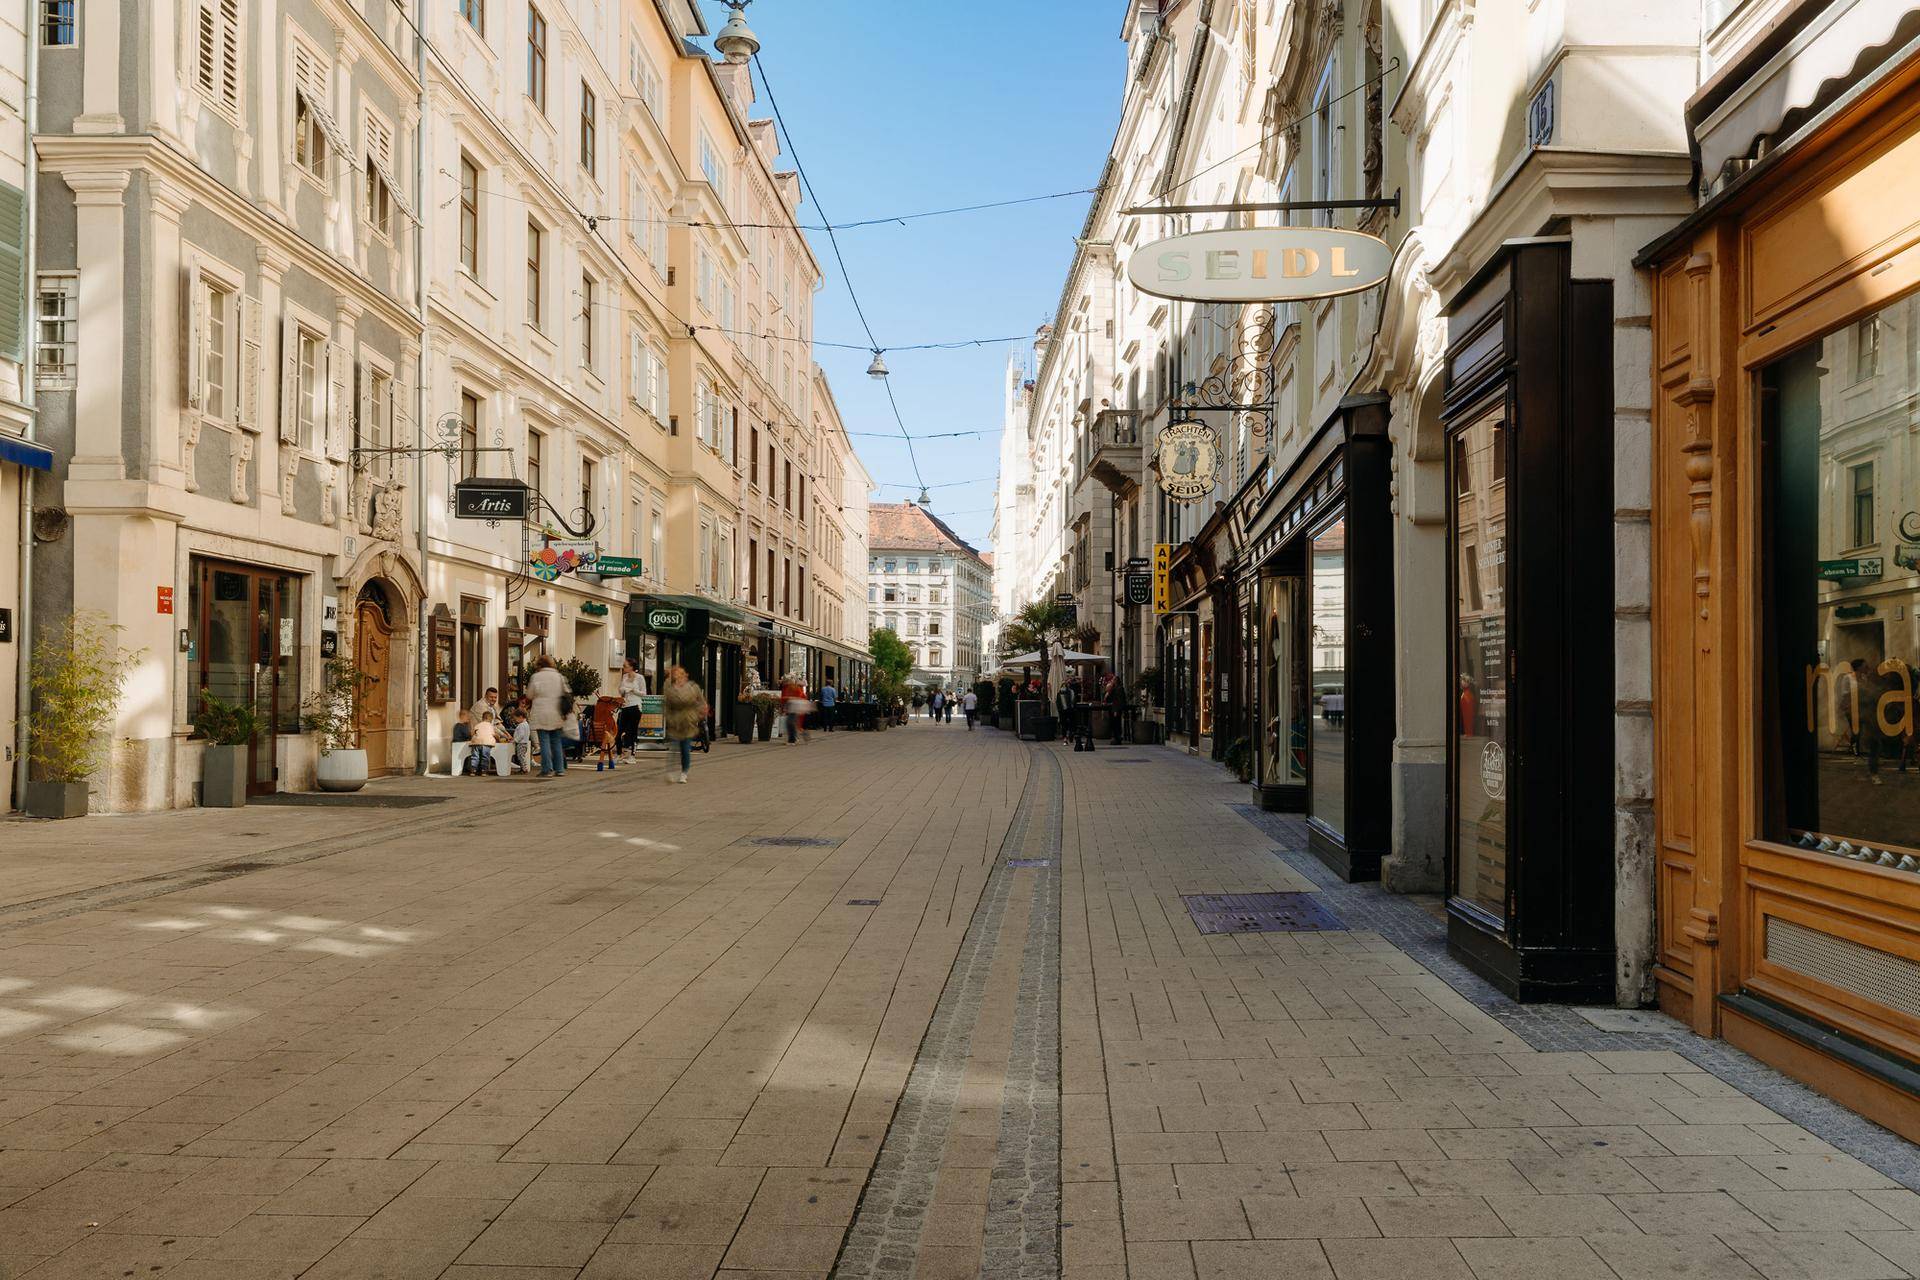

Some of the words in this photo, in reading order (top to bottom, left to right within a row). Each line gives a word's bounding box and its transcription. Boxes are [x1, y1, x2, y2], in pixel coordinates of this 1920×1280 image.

[1157, 247, 1360, 281] SEIDL
[1164, 426, 1211, 439] TRACHTEN
[1167, 483, 1209, 494] SEIDL
[468, 498, 512, 512] Artis
[606, 564, 631, 573] mundo
[1157, 548, 1167, 610] ANTIK
[653, 613, 679, 626] gössl
[1805, 658, 1914, 737] ma
